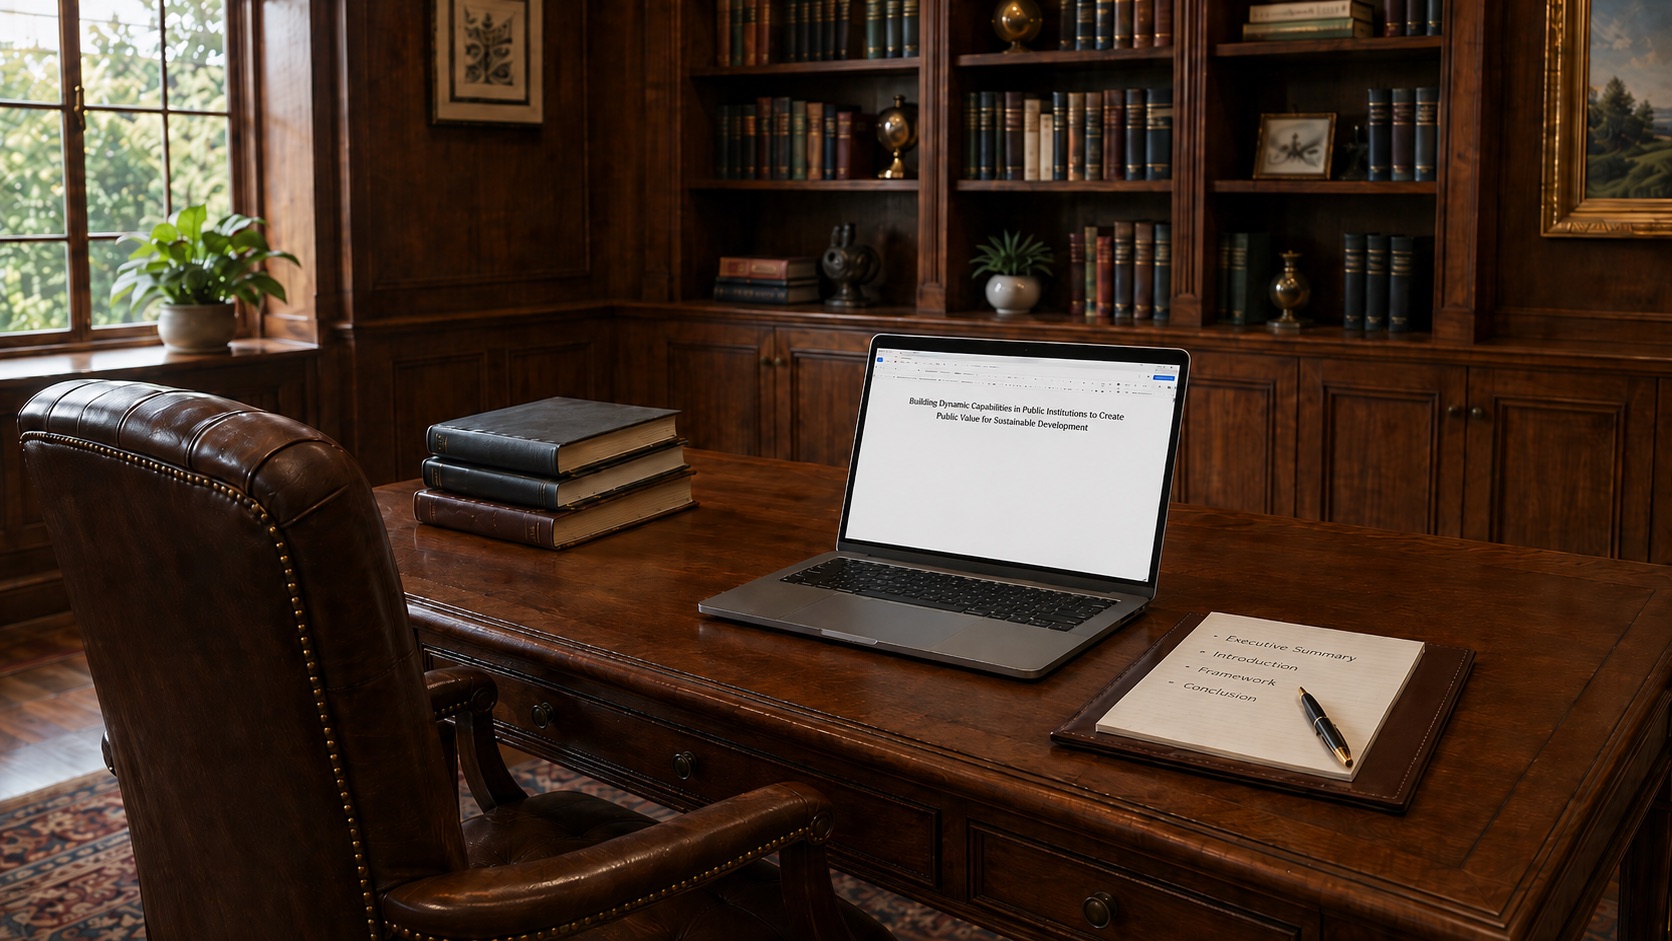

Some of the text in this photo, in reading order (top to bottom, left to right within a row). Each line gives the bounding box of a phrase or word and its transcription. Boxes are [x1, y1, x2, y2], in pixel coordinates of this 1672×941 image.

[909, 397, 1124, 421] Building Dynamic Capabilities in Public Institutions to Create
[936, 411, 1088, 432] Public Value for Sustainable Development
[1225, 635, 1357, 662] Executive Summary
[1213, 650, 1298, 671] Introduction
[1197, 666, 1276, 687] Framework
[1183, 682, 1257, 702] Conclusion
